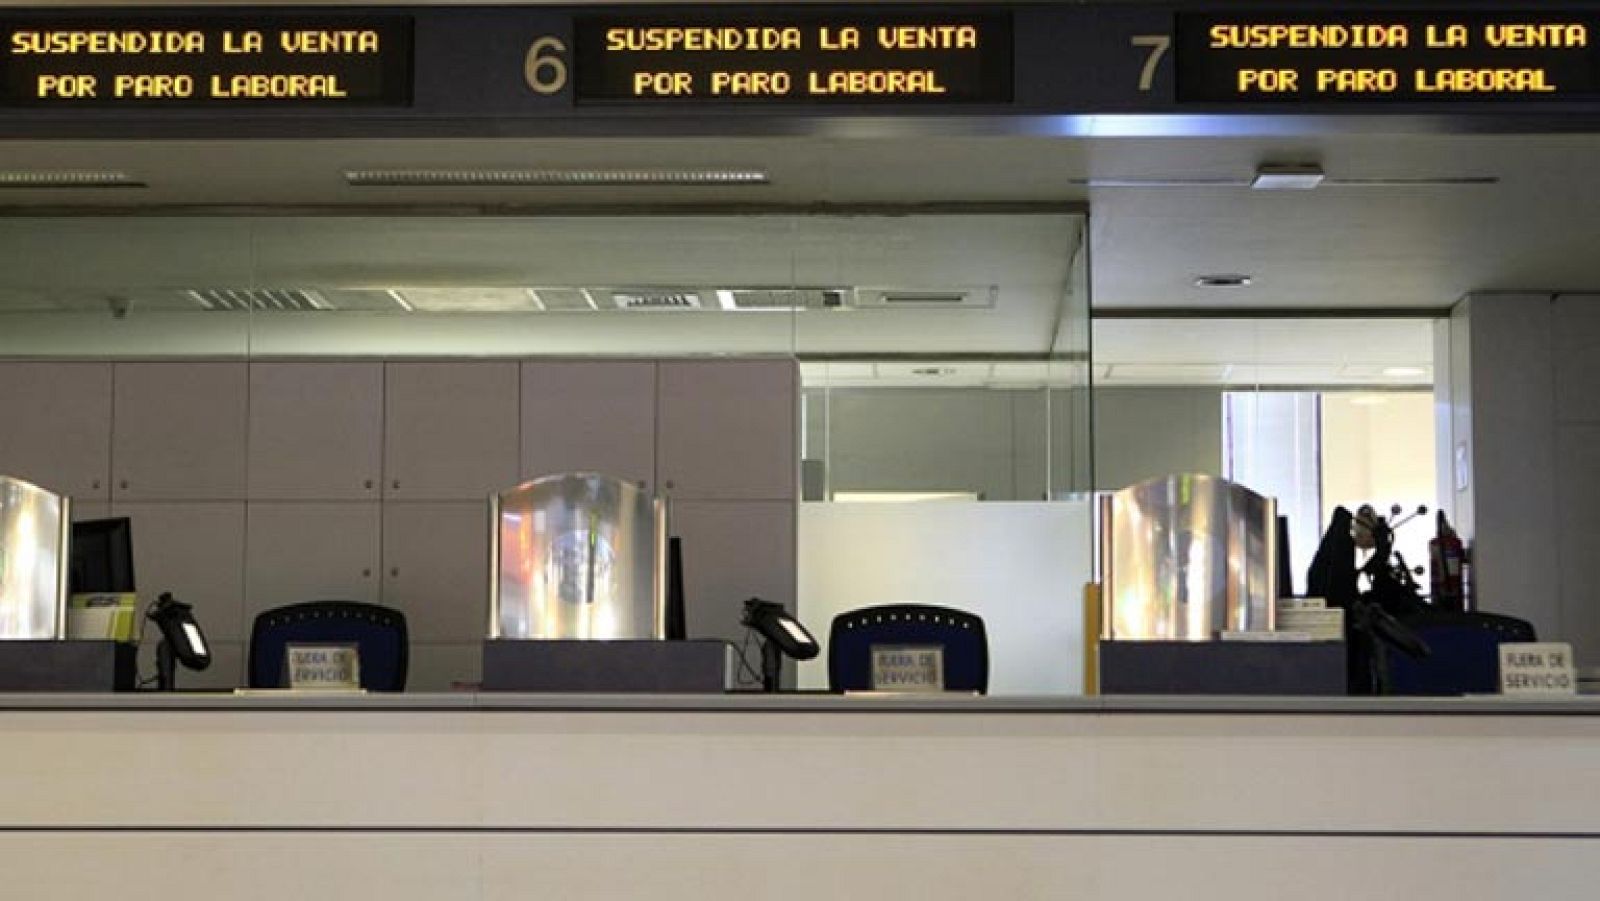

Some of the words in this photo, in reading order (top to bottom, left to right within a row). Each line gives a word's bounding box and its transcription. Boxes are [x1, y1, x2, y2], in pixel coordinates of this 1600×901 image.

[11, 31, 205, 53] SUSPENDIDA
[222, 31, 263, 53] LA
[280, 30, 378, 53] VENTA
[606, 28, 801, 50] SUSPENDIDA
[820, 27, 859, 49] LA
[878, 26, 976, 49] VENTA
[1210, 25, 1408, 48] SUSPENDIDA
[1426, 25, 1468, 47] LA
[1485, 25, 1586, 47] VENTA
[524, 37, 567, 93] 6
[1132, 36, 1170, 90] 7
[38, 75, 97, 97] POR
[114, 75, 193, 97] PARO
[211, 75, 347, 97] LABORAL
[634, 72, 693, 95] POR
[711, 72, 791, 95] PARO
[809, 71, 945, 93] LABORAL
[1238, 69, 1298, 92] POR
[1317, 69, 1397, 91] PARO
[1415, 69, 1555, 91] LABORAL
